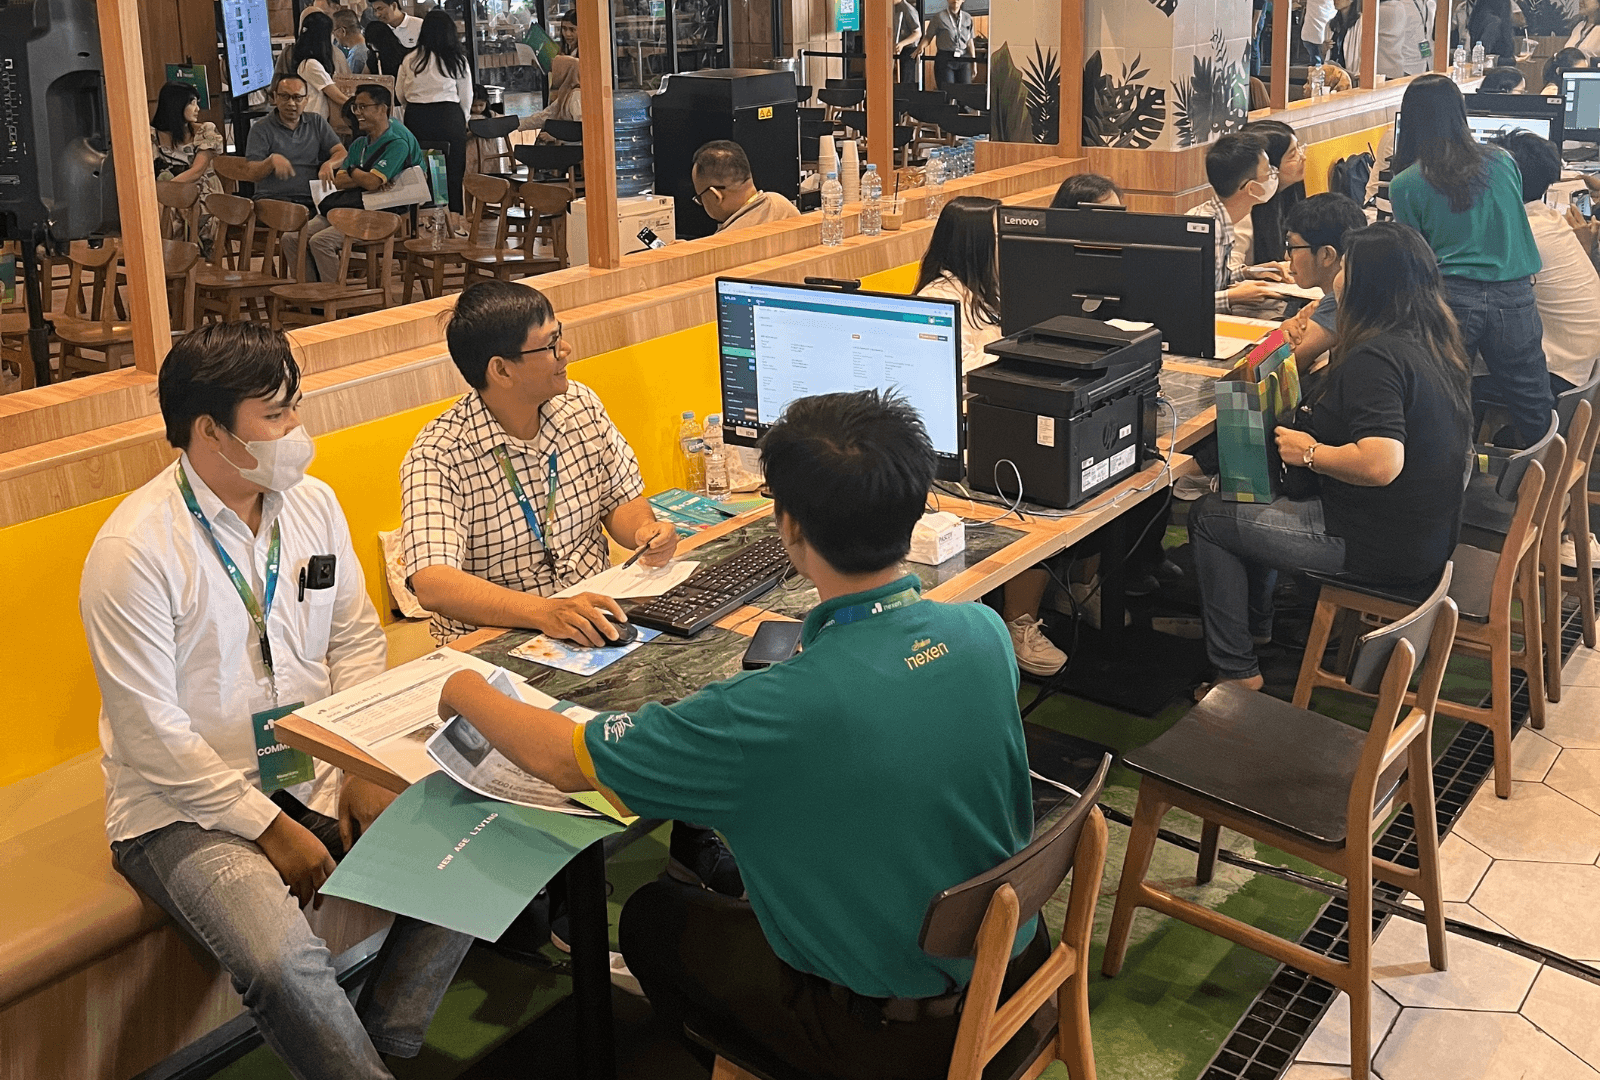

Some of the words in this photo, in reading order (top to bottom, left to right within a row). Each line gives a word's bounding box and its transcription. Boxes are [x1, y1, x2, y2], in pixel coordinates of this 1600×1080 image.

[1004, 215, 1039, 226] Lenovo
[883, 600, 902, 611] nexen
[904, 642, 949, 671] nexen
[436, 854, 454, 870] NEW
[454, 837, 471, 853] AGE
[469, 812, 499, 836] LIVING
